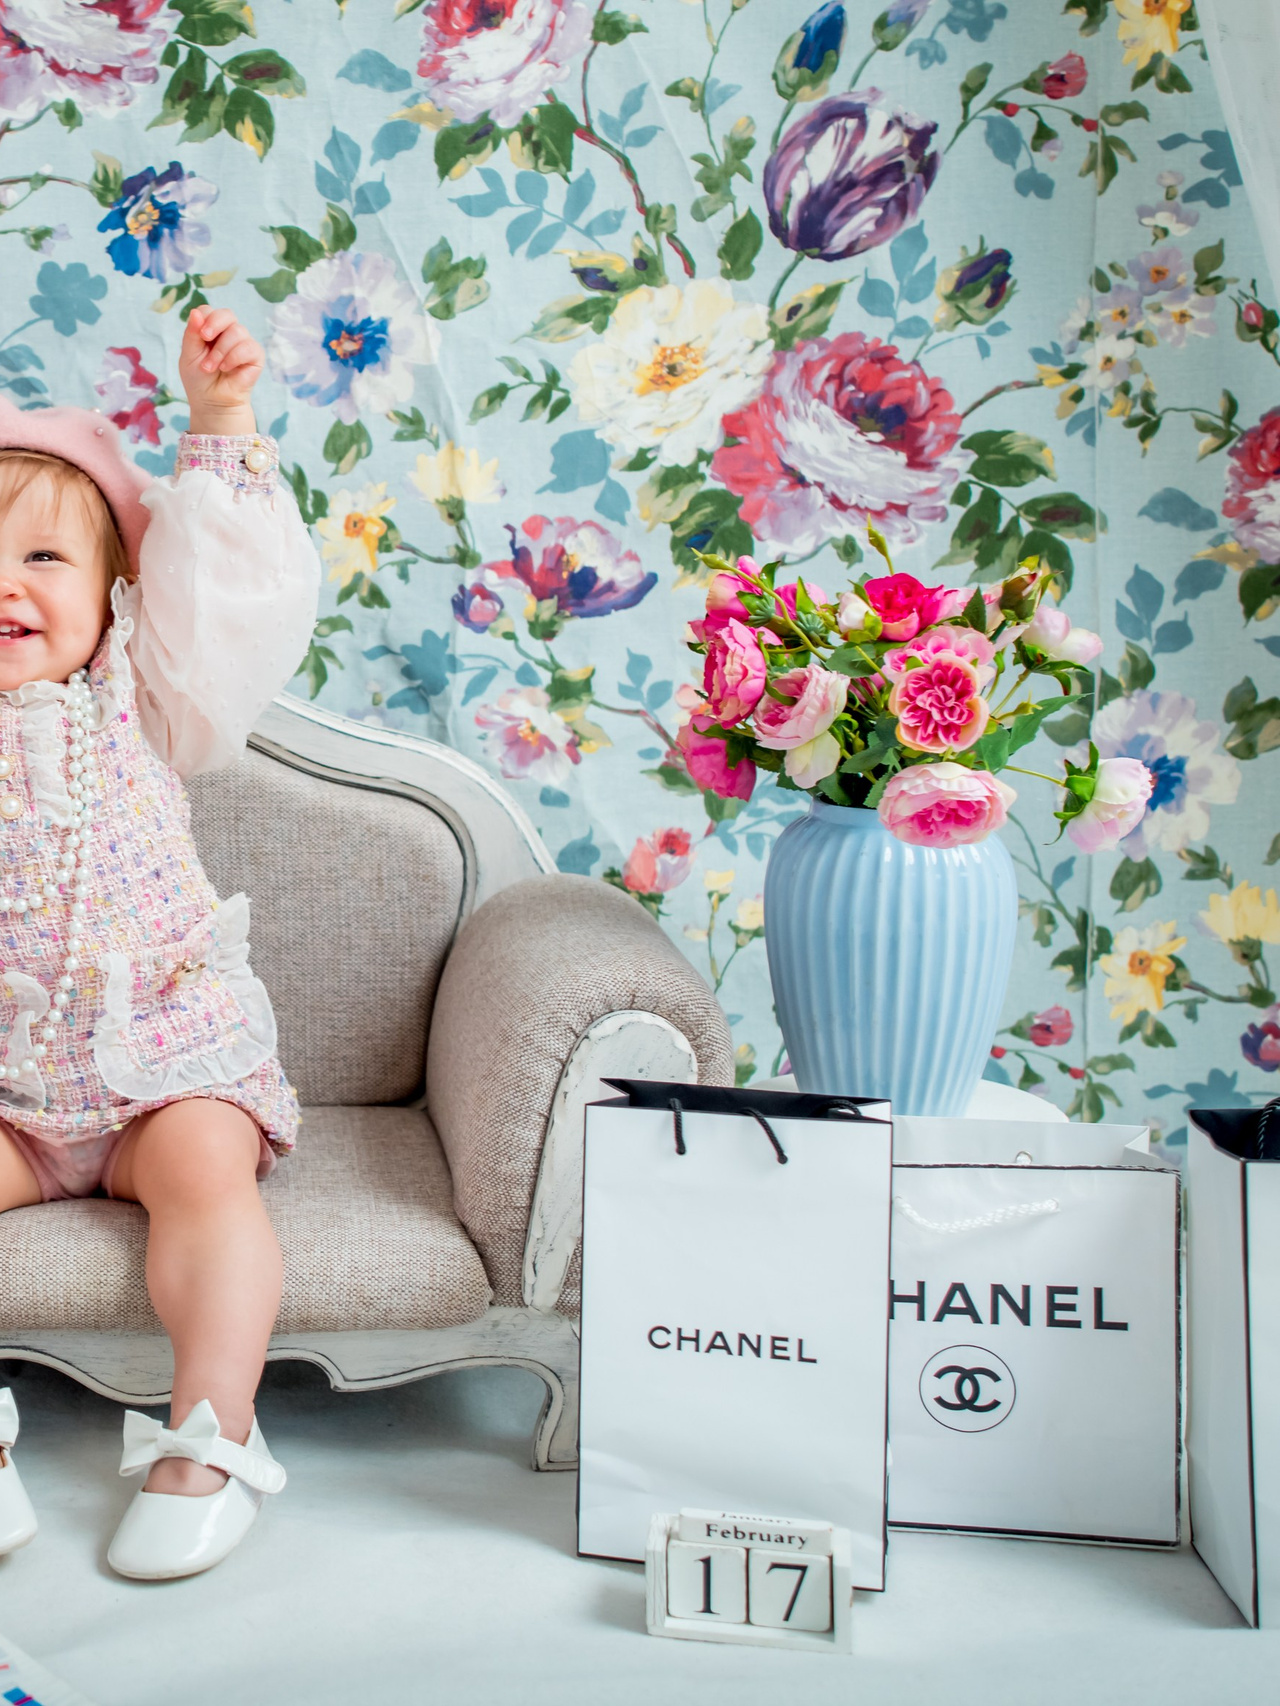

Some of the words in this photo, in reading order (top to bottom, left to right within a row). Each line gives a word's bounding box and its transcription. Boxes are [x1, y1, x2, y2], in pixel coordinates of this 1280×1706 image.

[889, 1279, 1129, 1331] HANEL
[647, 1325, 818, 1364] CHANEL
[706, 1523, 808, 1549] February
